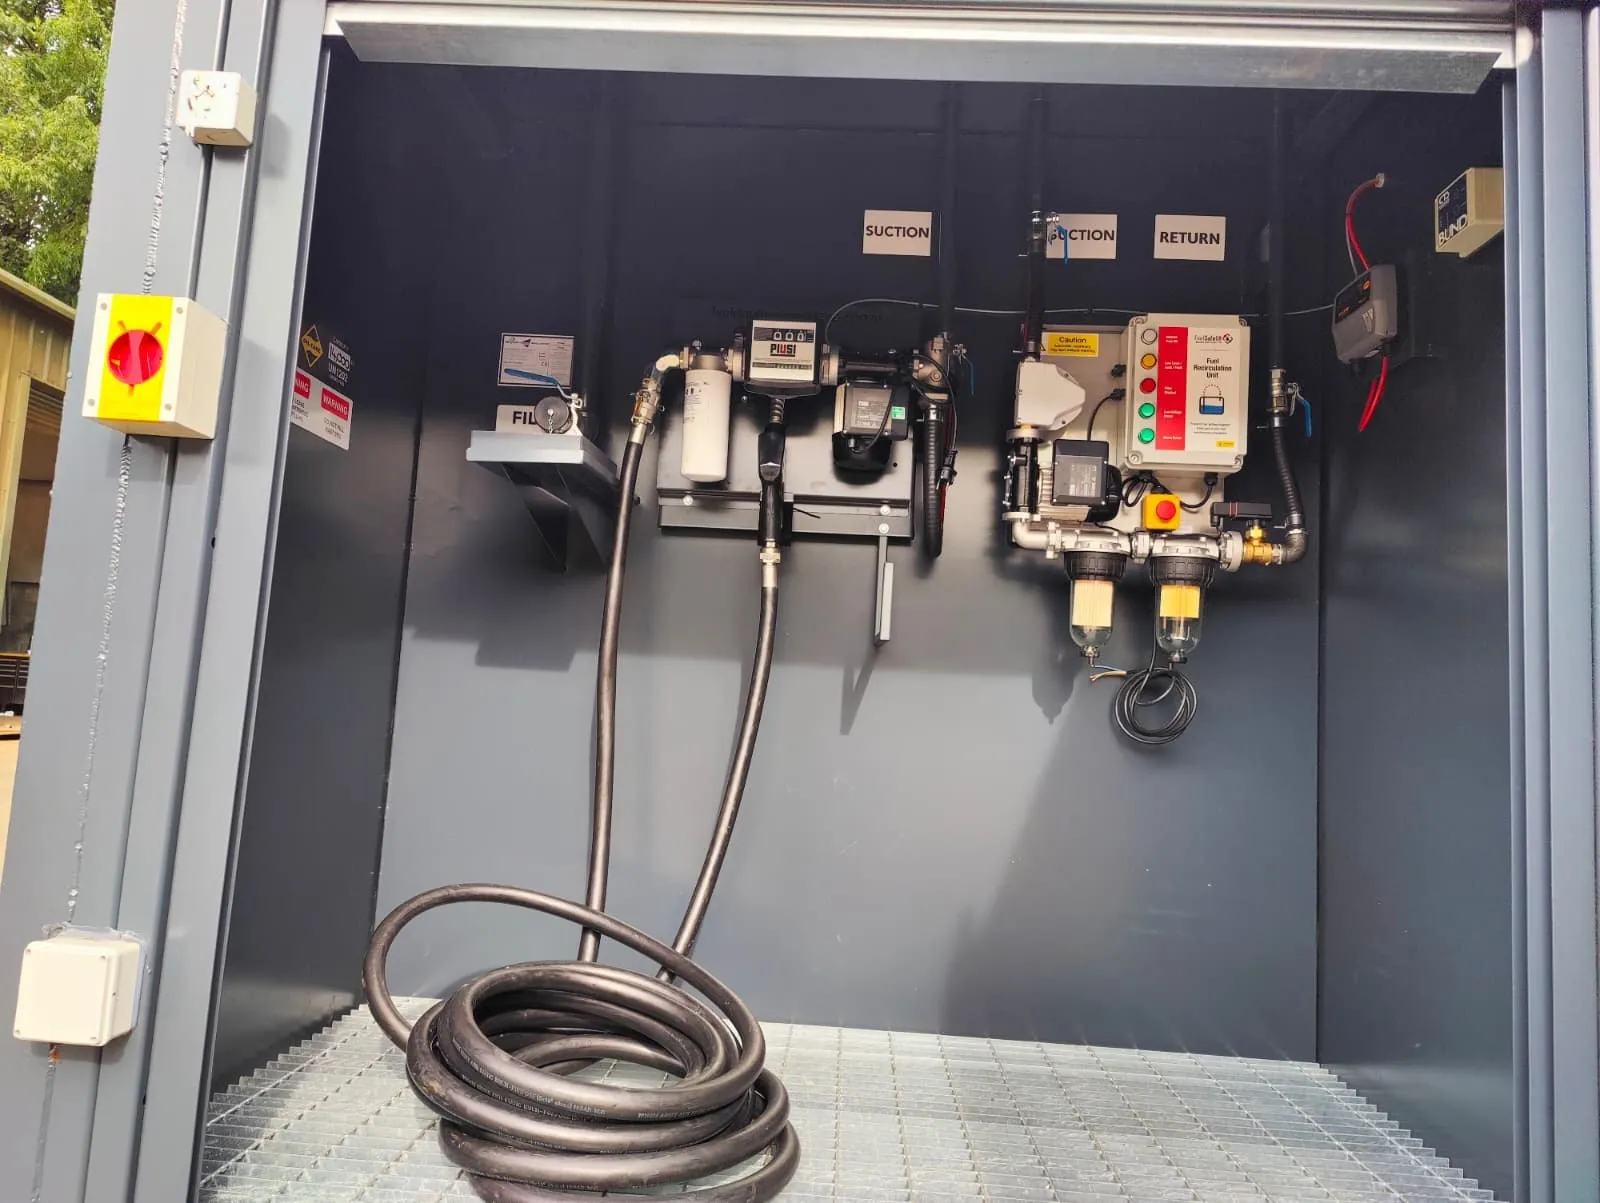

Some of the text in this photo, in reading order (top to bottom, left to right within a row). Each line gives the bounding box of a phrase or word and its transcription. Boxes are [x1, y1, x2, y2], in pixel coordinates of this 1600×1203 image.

[865, 225, 930, 239] SUCTION
[1438, 213, 1468, 247] BUND
[1159, 231, 1221, 245] RETURN
[1058, 335, 1087, 344] Caution
[770, 343, 797, 354] PIUSI
[322, 394, 349, 416] WARNING
[512, 410, 537, 425] FIL
